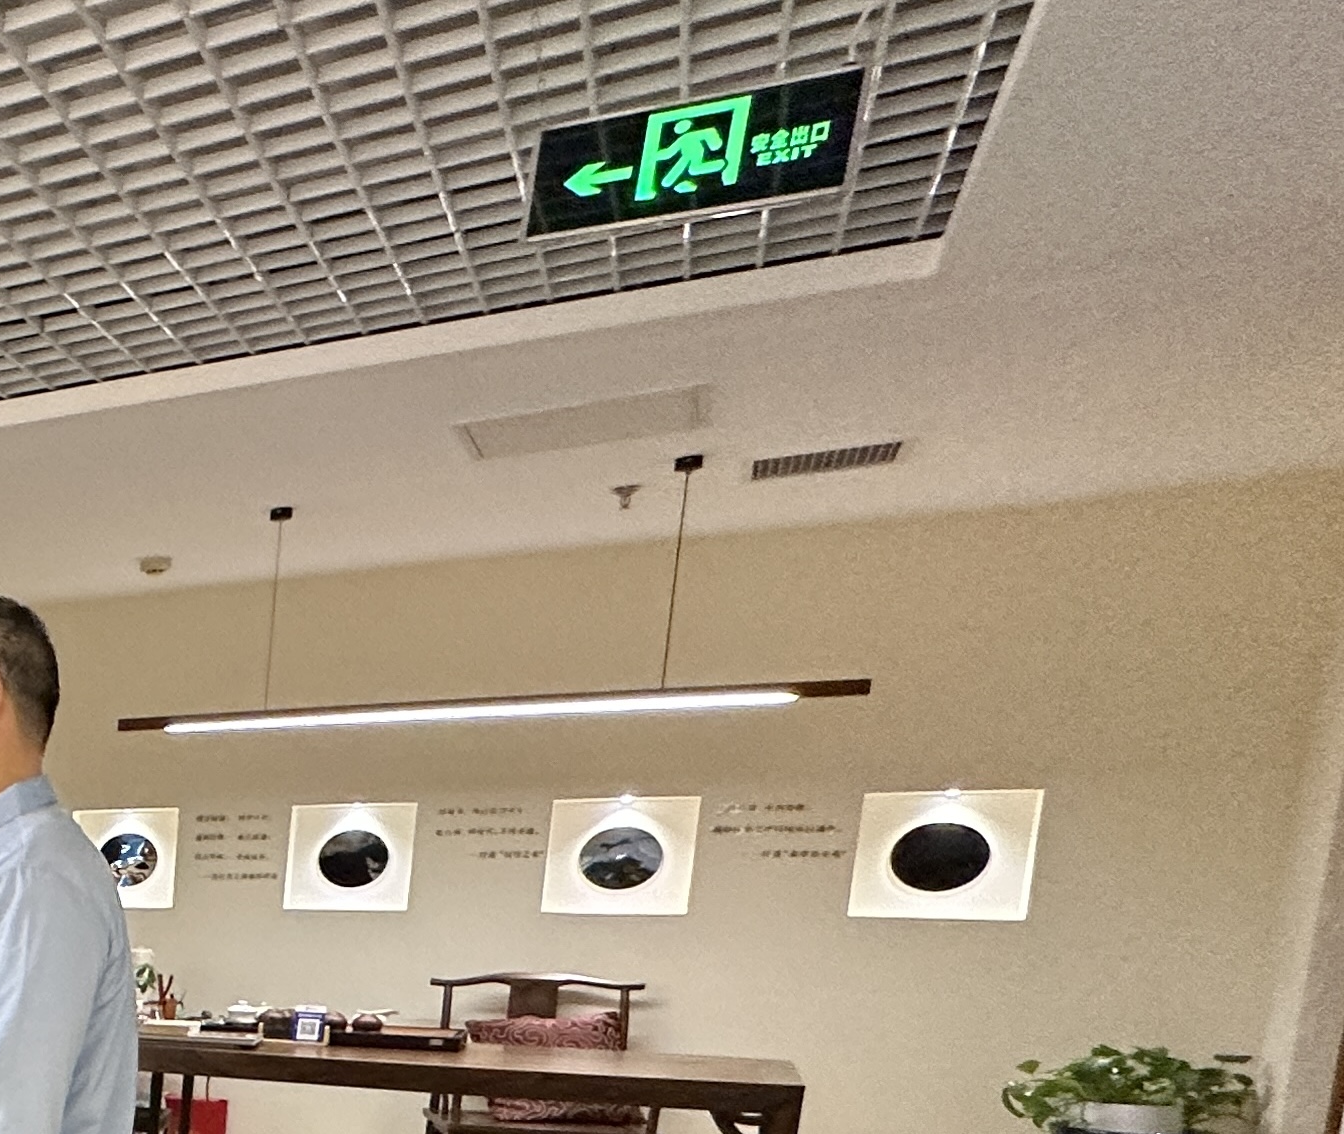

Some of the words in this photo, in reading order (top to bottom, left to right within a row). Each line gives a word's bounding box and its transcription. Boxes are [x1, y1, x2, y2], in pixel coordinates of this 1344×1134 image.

[749, 119, 832, 154] 安全出口
[755, 143, 818, 167] EXIT
